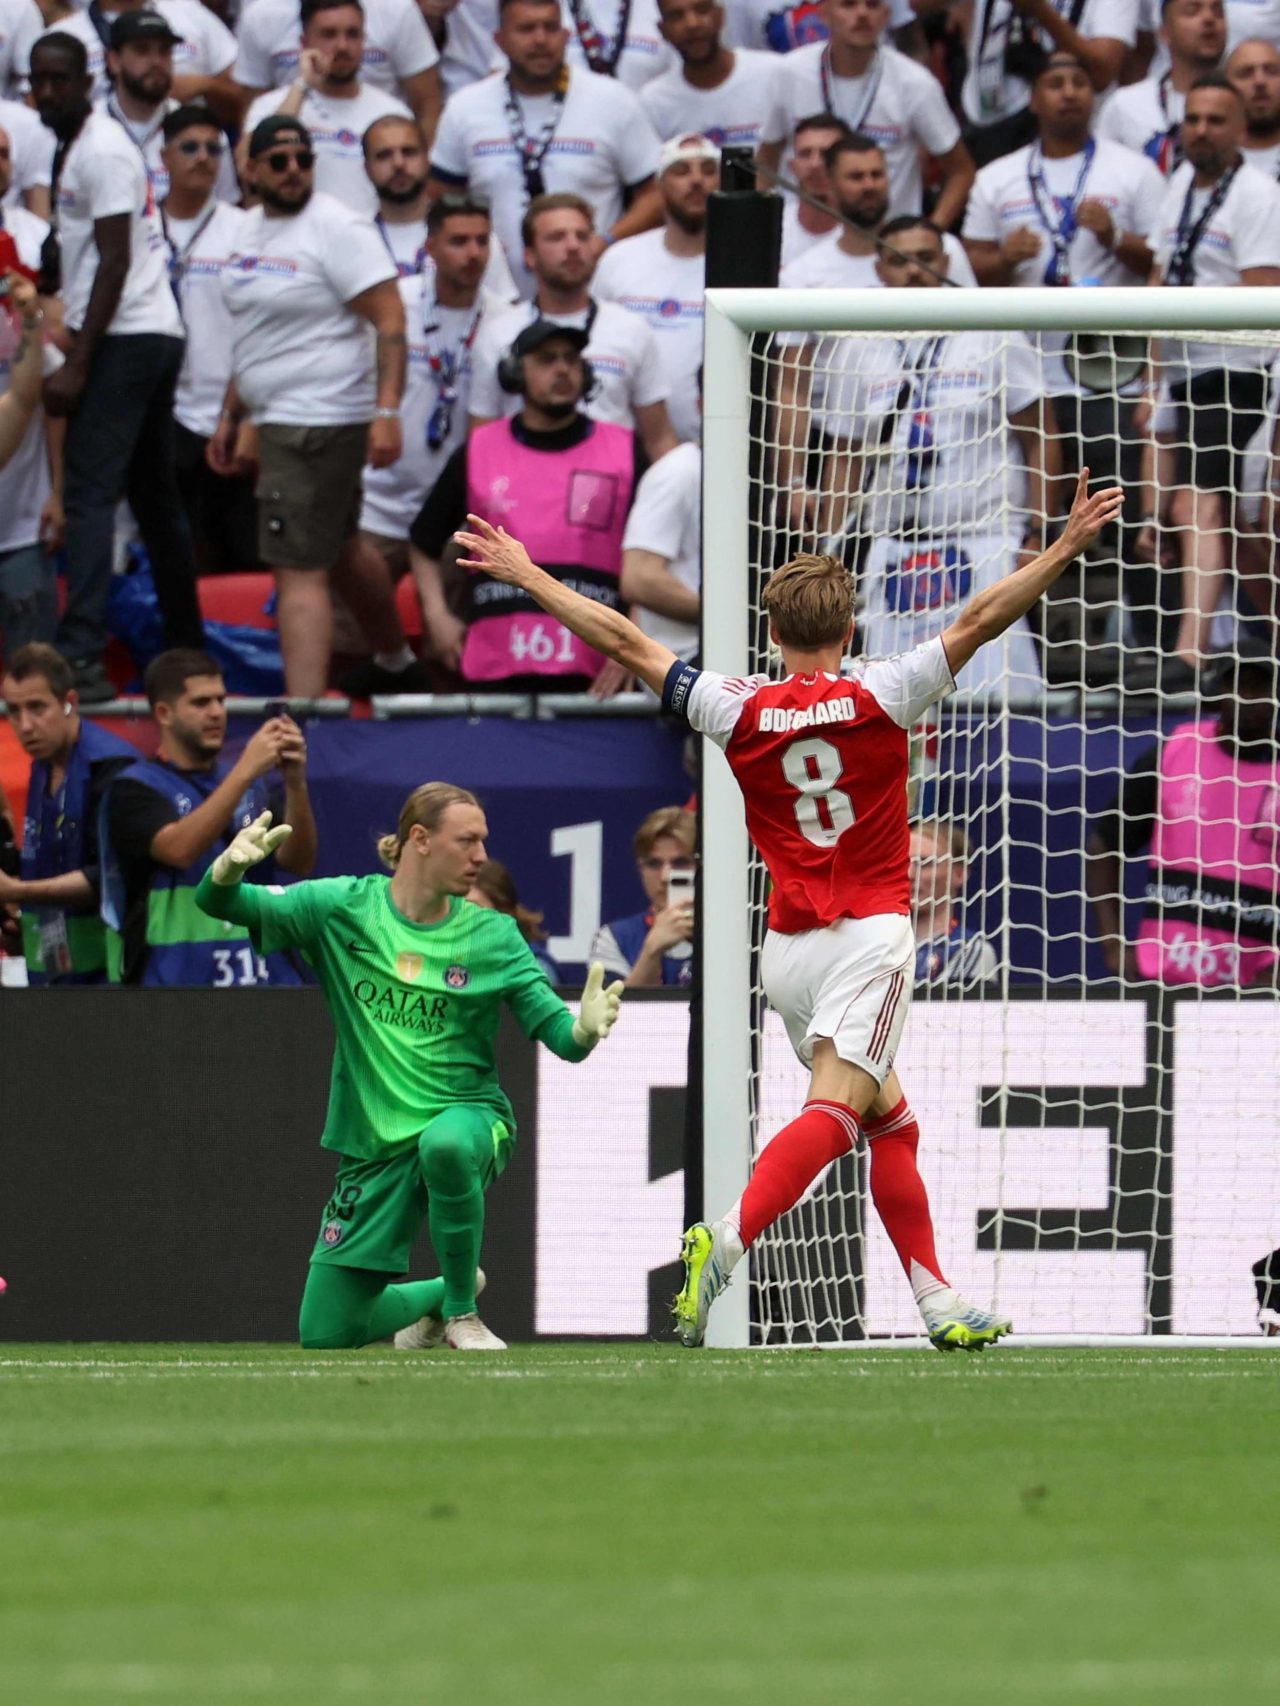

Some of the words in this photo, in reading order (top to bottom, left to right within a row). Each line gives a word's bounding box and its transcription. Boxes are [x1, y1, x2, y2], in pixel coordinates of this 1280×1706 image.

[780, 736, 857, 849] 8
[353, 979, 449, 1019] QATAR
[373, 1008, 446, 1035] AIRWAYS
